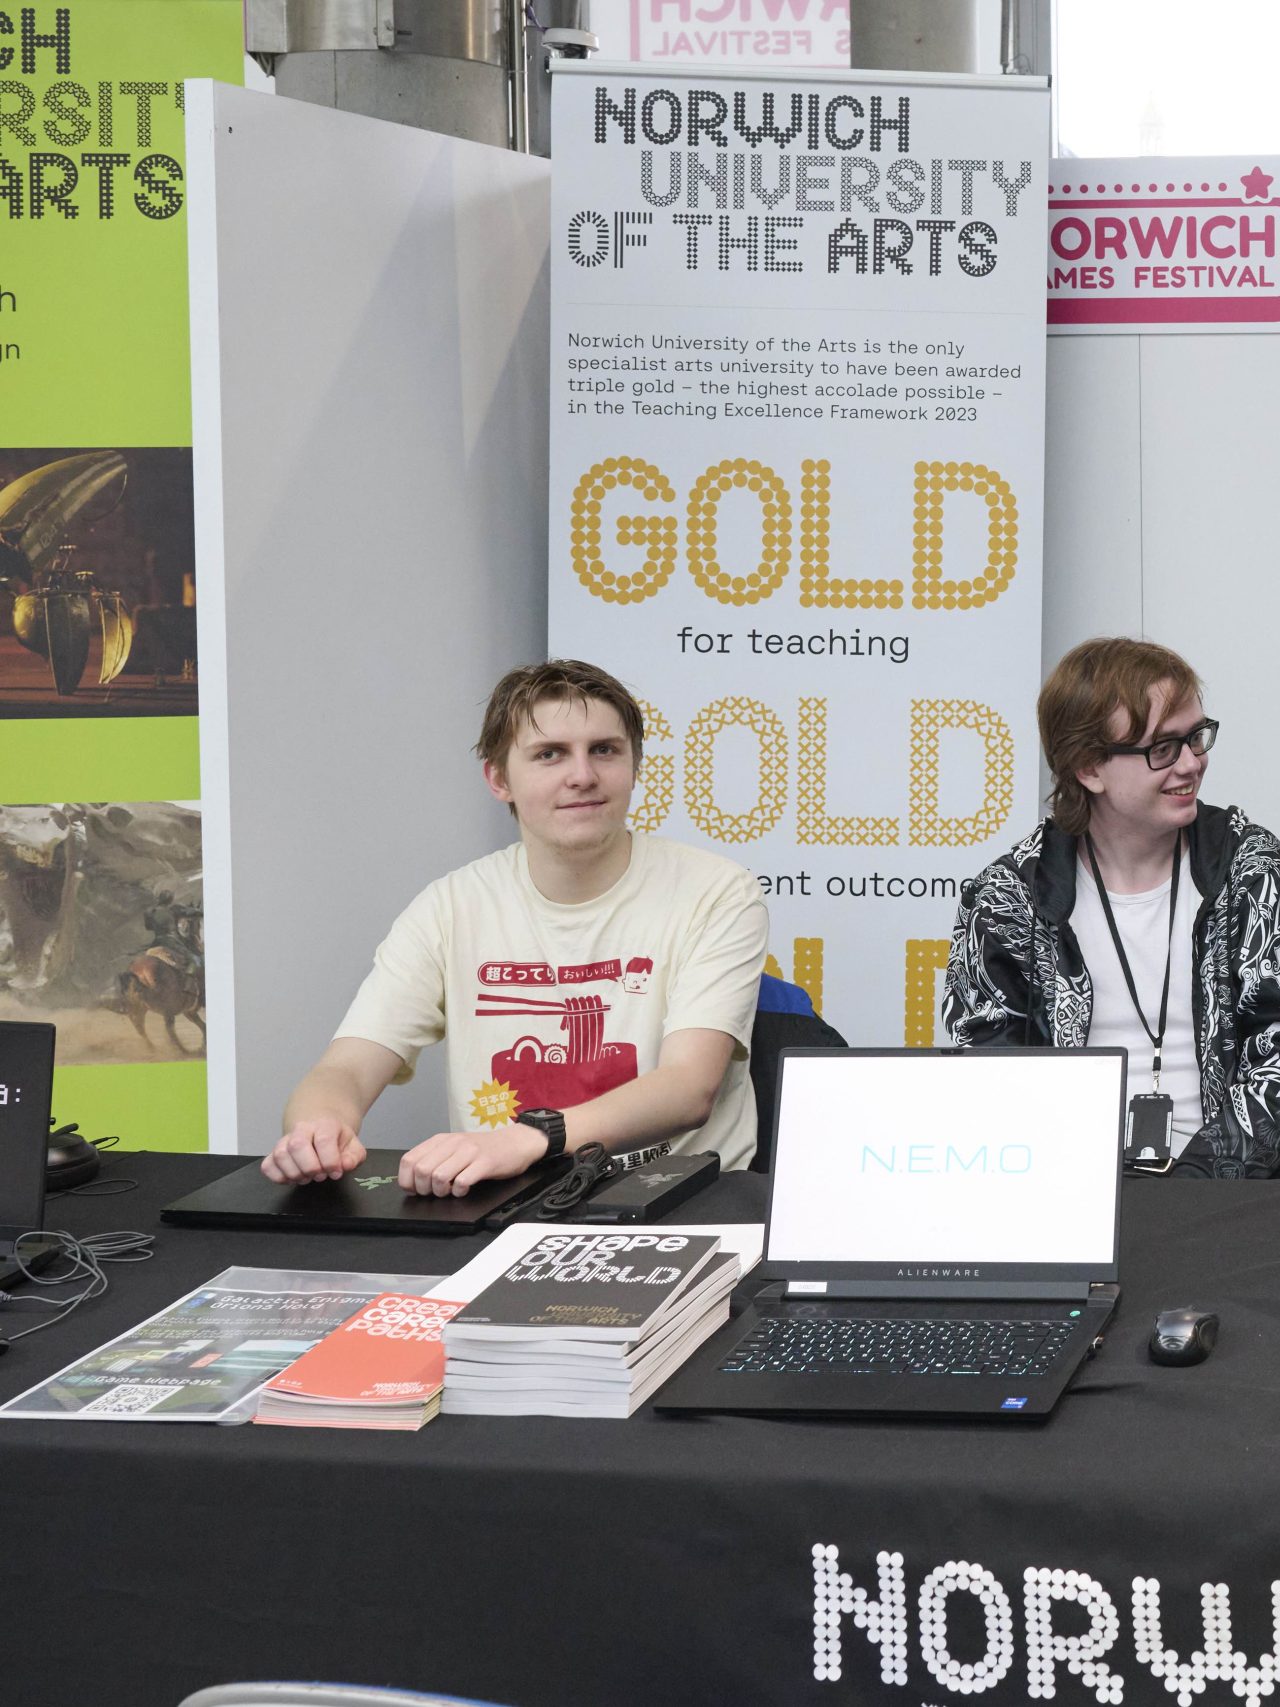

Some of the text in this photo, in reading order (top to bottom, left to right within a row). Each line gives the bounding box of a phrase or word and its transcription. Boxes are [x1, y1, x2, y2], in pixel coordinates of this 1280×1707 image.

[0, 80, 184, 147] RSIT
[594, 86, 910, 153] NORWICH
[640, 150, 1032, 217] UNIVERSITY
[567, 210, 998, 278] OF THE ARTS
[1135, 265, 1275, 288] FESTIVAL
[568, 333, 965, 359] Norwich University of the Arts is the only
[568, 356, 1021, 379] specialist arts university to have been awarded
[568, 378, 985, 401] triple gold the highest accolade possible
[568, 400, 977, 421] in the Teaching Excellence Framework 2023
[570, 456, 1019, 610] GOLD
[677, 626, 910, 664] for teaching
[861, 1145, 1031, 1174] N.E.M.O
[521, 1250, 616, 1267] OUR
[505, 1265, 681, 1284] WORLD
[897, 1269, 981, 1277] ALIENWARE
